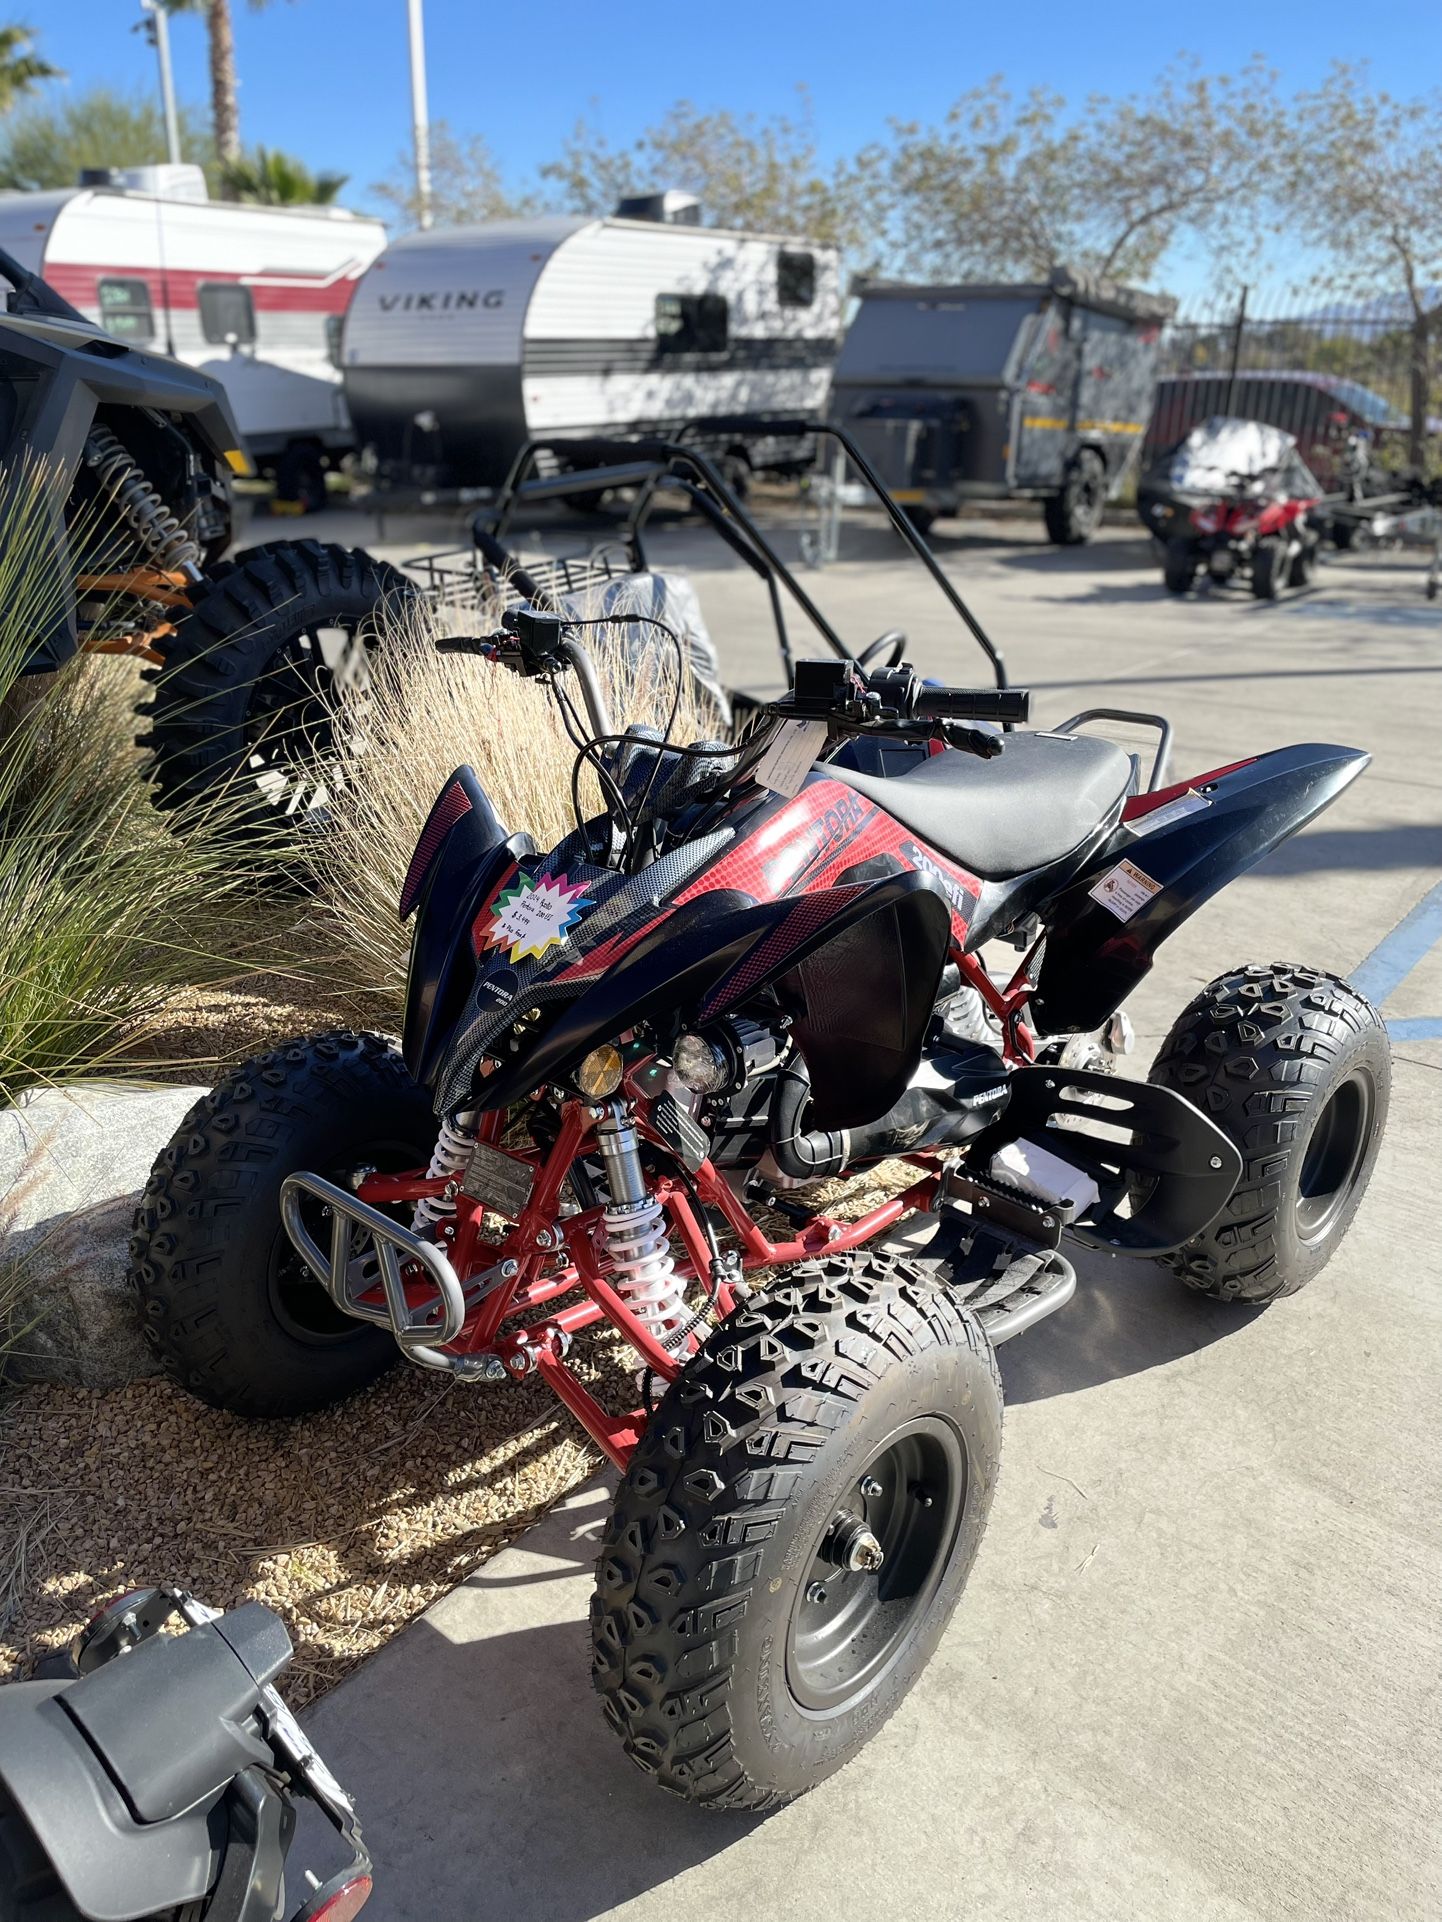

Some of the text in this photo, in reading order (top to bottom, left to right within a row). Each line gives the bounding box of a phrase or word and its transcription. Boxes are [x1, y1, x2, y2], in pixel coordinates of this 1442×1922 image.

[378, 289, 506, 312] VIKING
[1133, 872, 1156, 890] WARNING
[482, 981, 514, 1002] PENTORA
[972, 1083, 1008, 1107] PENTORA
